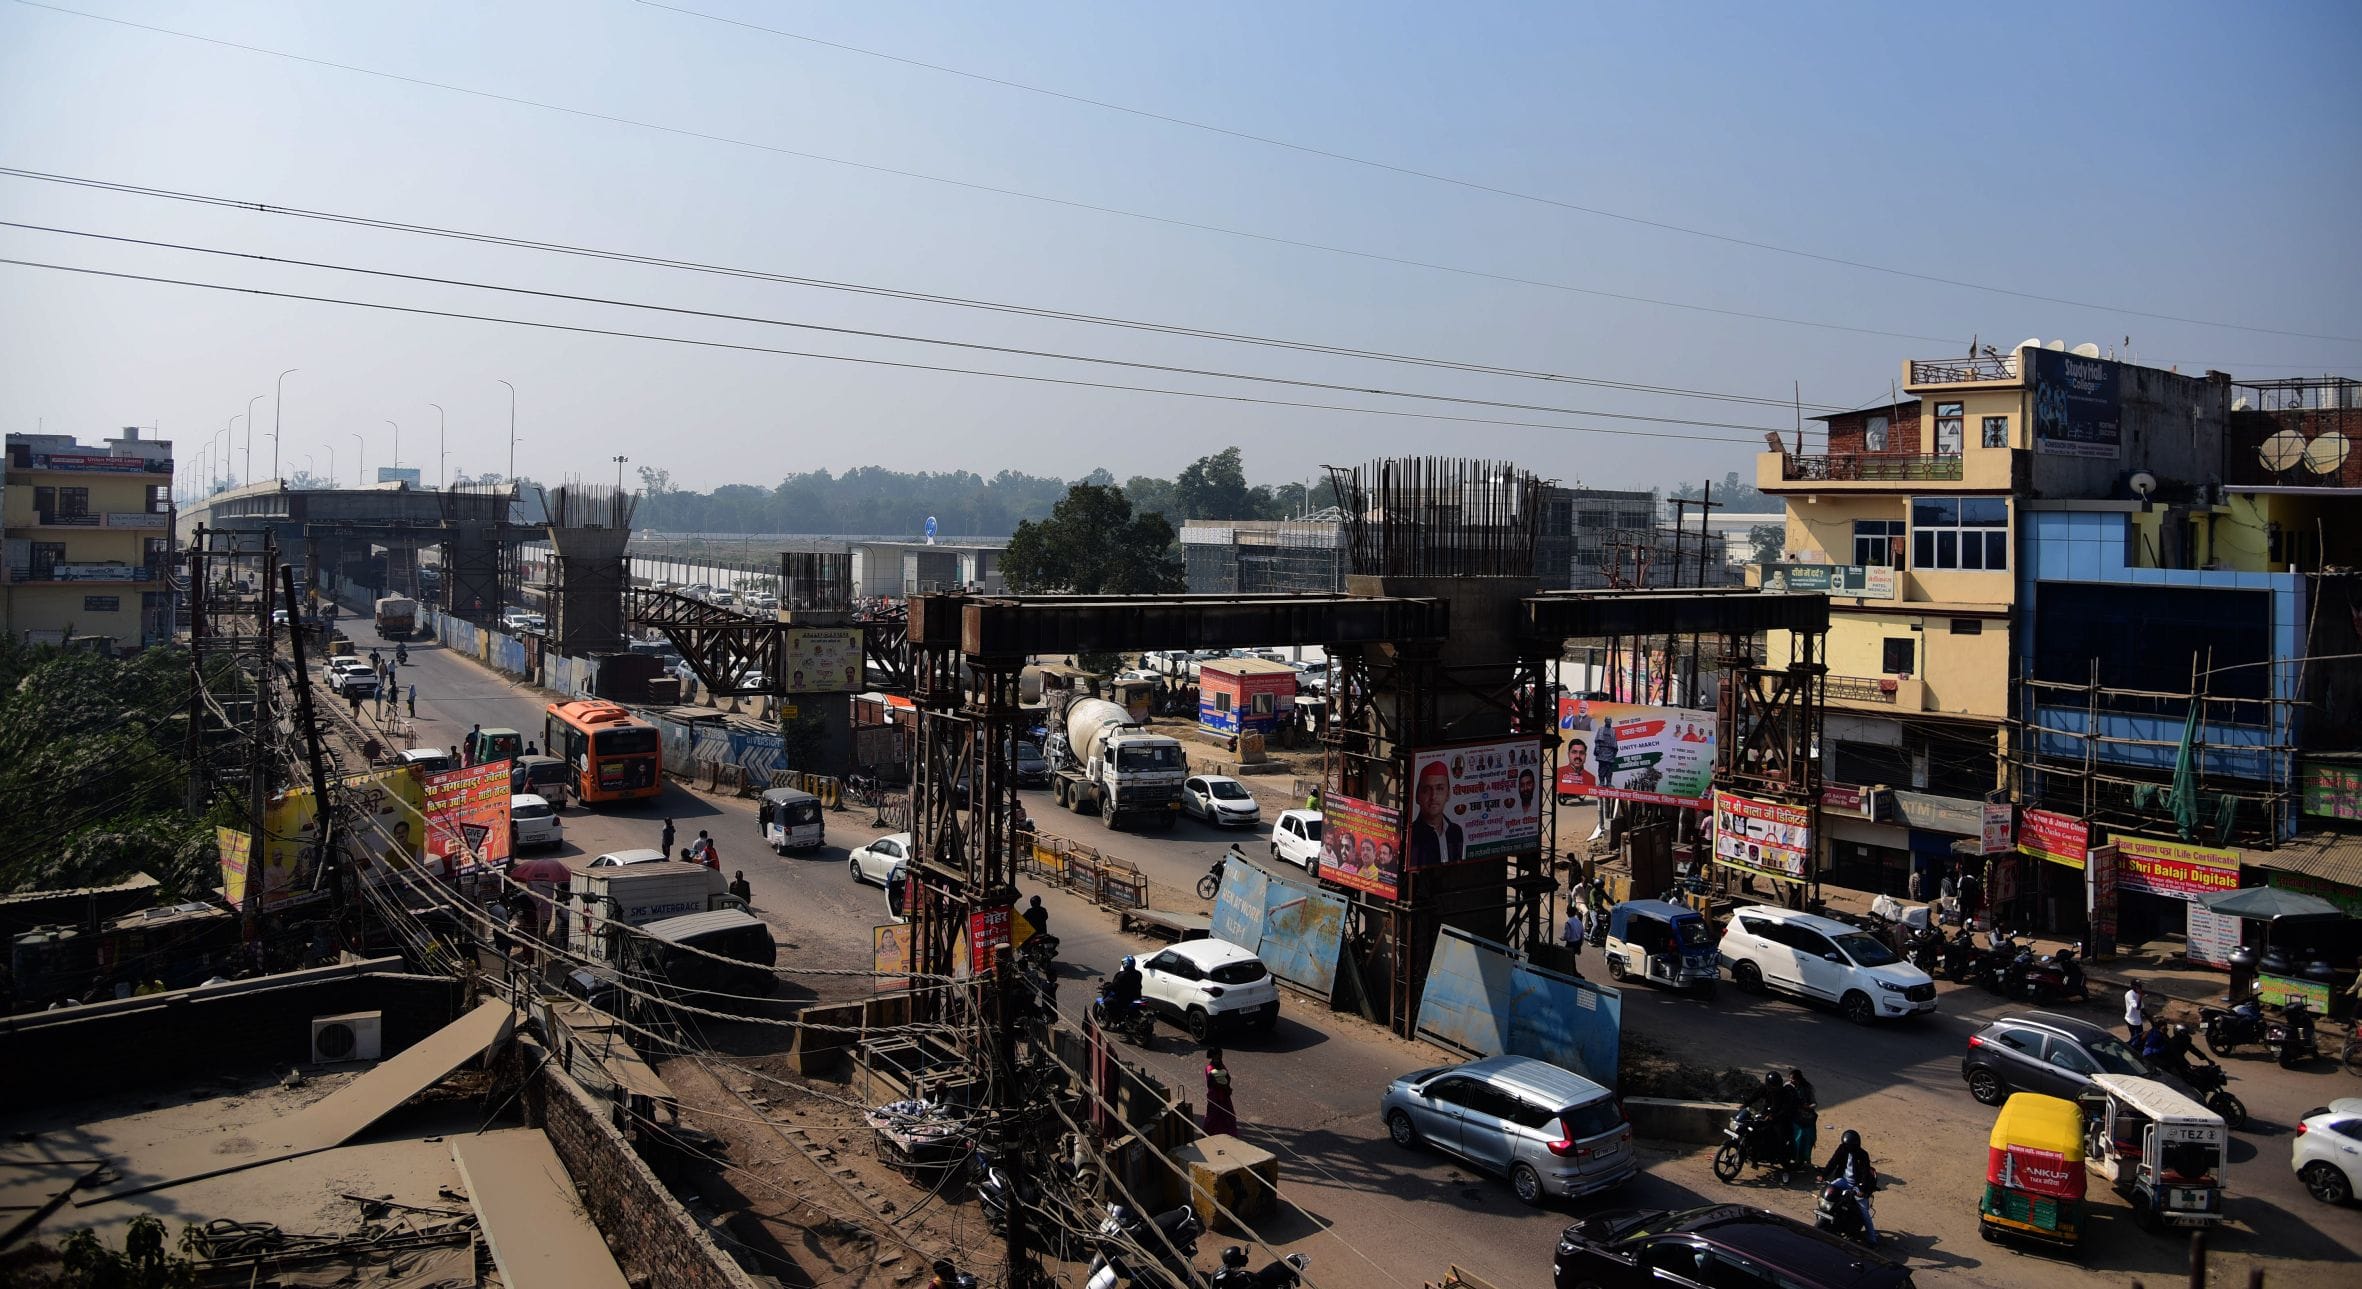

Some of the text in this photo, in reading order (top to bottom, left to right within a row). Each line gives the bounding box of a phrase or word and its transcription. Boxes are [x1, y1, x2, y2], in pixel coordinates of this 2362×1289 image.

[2072, 378, 2095, 394] College
[746, 736, 780, 747] DIVERSION
[1619, 741, 1660, 751] UNITY-MARCH
[1901, 800, 1930, 817] ATM
[2054, 818, 2069, 828] Joint
[2070, 822, 2087, 833] Clinic
[466, 829, 481, 838] GIVE
[2193, 851, 2238, 868] Certificate)
[2129, 859, 2151, 873] Shri
[2154, 863, 2188, 880] Balaji
[2191, 869, 2237, 888] Digitals
[631, 902, 700, 917] SMS WATERGRACE
[1242, 899, 1260, 923] WORK
[2180, 1129, 2203, 1139] TEZ
[2025, 1166, 2069, 1180] ANKUR
